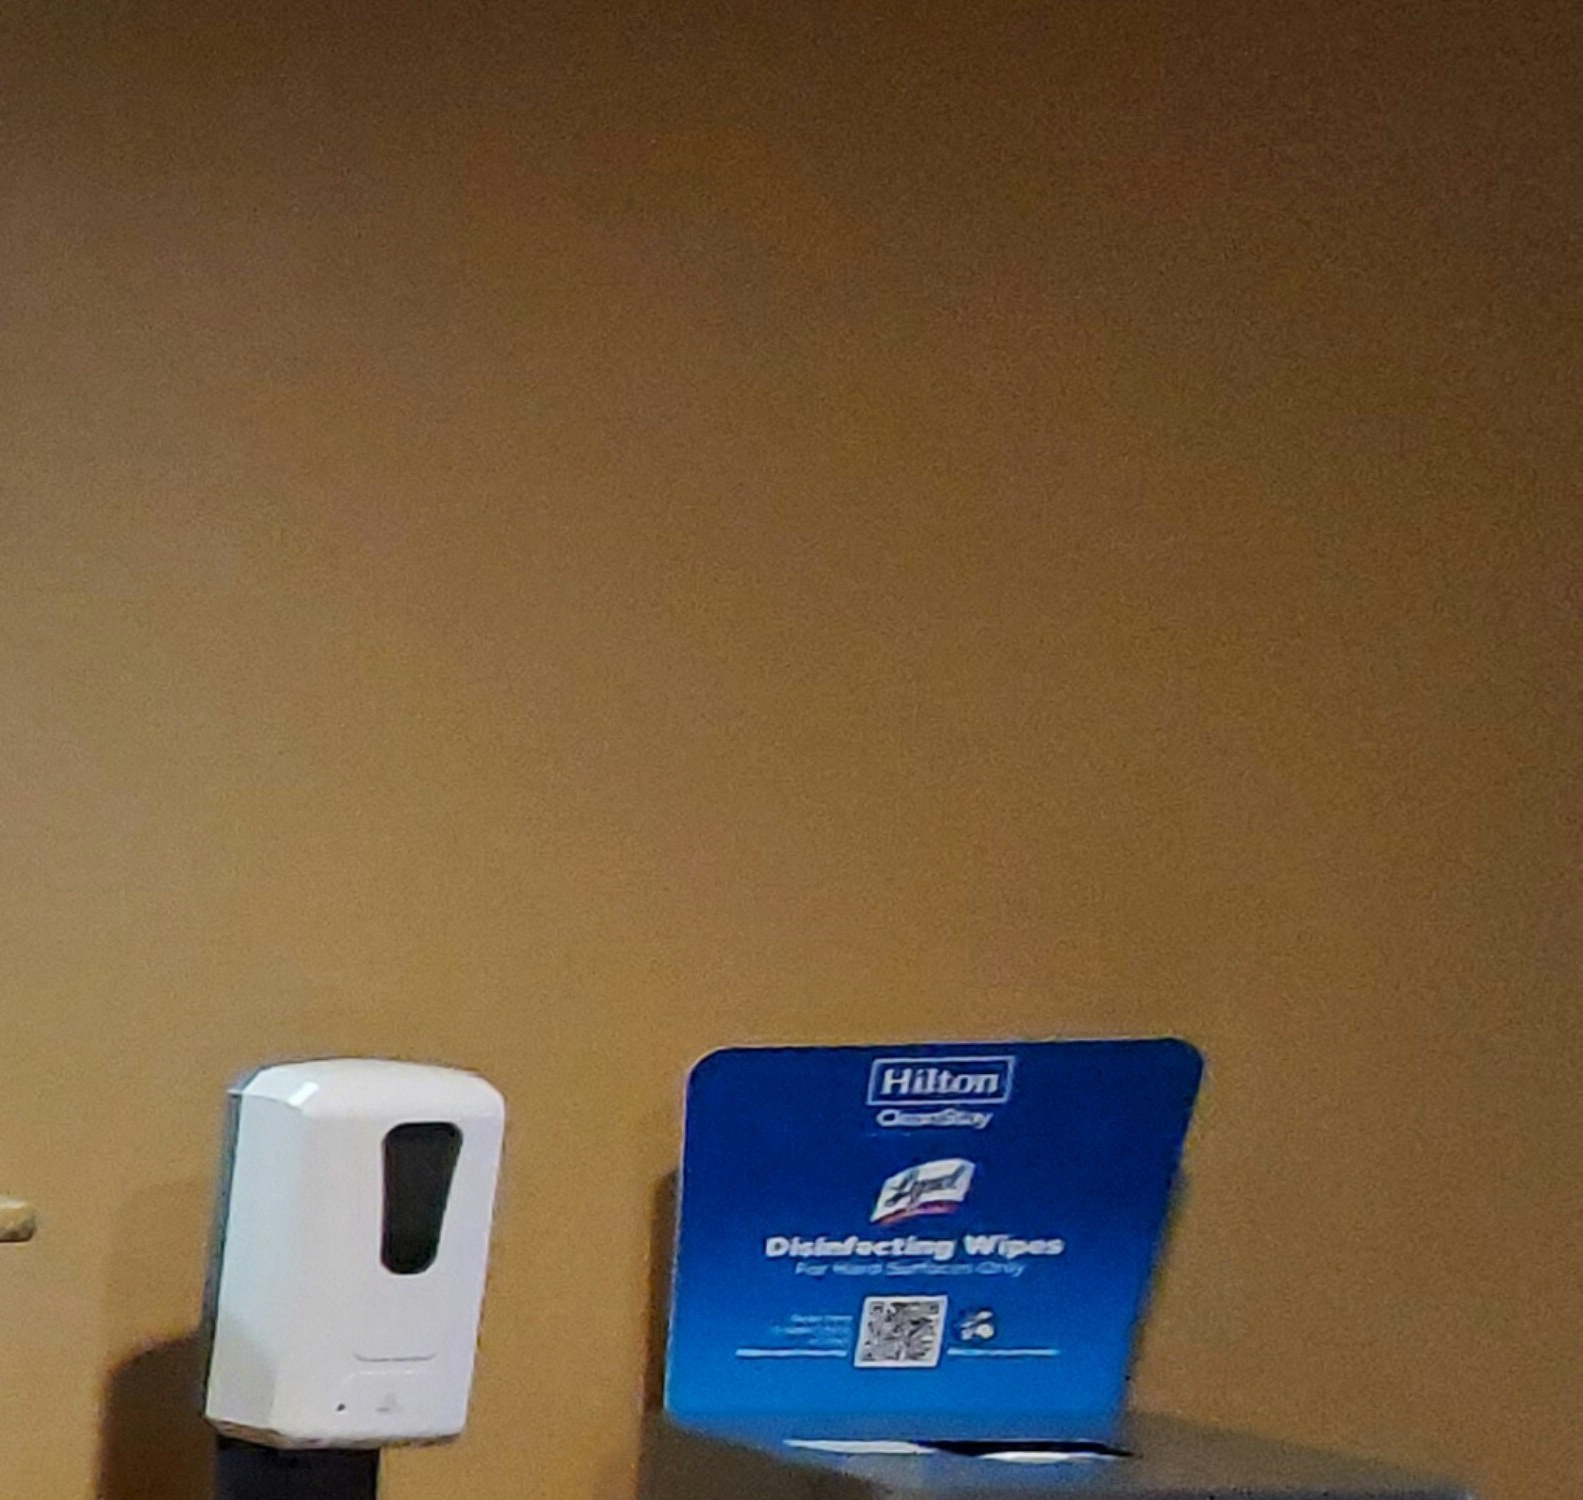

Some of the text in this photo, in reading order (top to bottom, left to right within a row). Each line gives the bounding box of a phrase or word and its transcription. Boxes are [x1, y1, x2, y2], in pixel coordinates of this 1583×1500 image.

[879, 1067, 1000, 1096] Hilton
[765, 1234, 1065, 1261] Disinfecting Wipes
